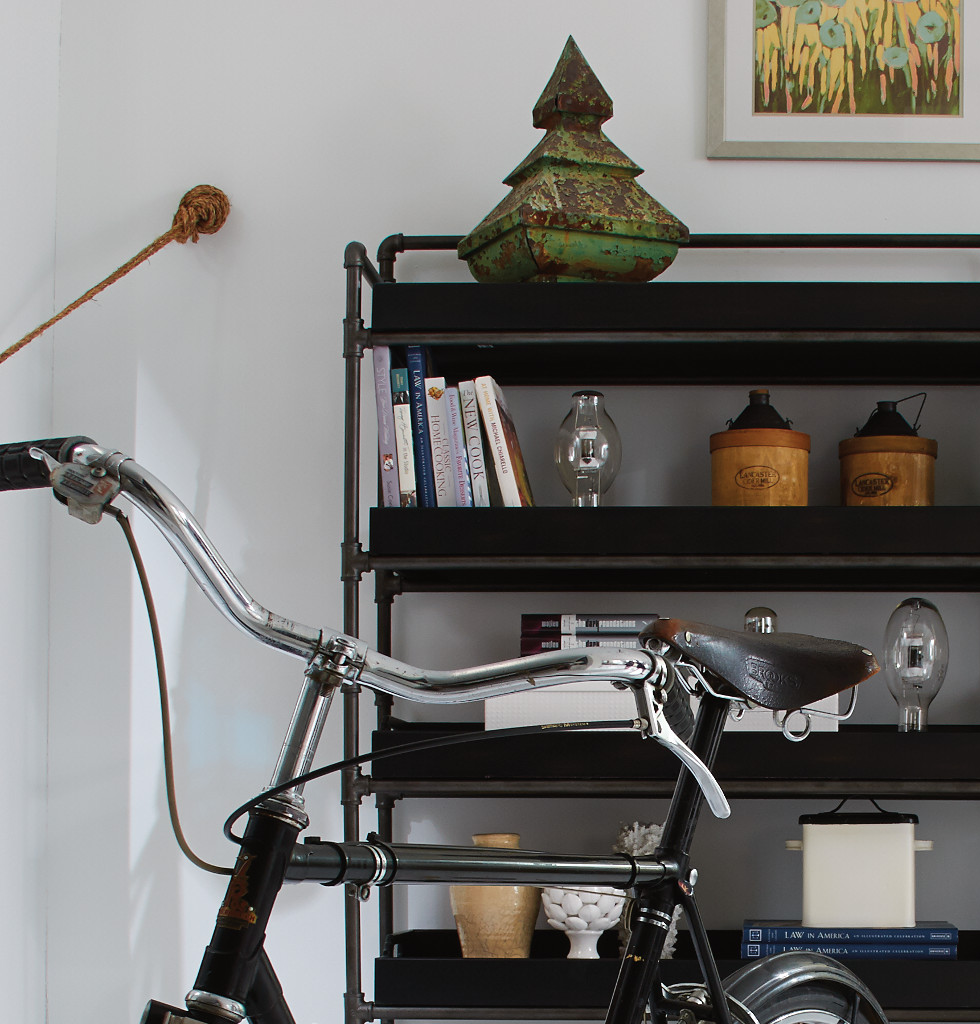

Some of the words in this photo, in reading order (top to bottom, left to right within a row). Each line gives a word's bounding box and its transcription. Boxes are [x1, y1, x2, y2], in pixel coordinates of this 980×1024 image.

[376, 366, 387, 393] STYLE
[412, 369, 422, 389] LAW
[414, 401, 425, 433] AMERICA
[430, 414, 442, 445] HOME
[462, 397, 478, 432] NEW
[489, 421, 500, 445] MICHAEL
[441, 437, 452, 472] CLASSIC
[467, 434, 485, 480] COOK
[432, 445, 448, 497] COOKING
[740, 470, 777, 478] LANCASTER
[855, 478, 889, 486] LANCASTER
